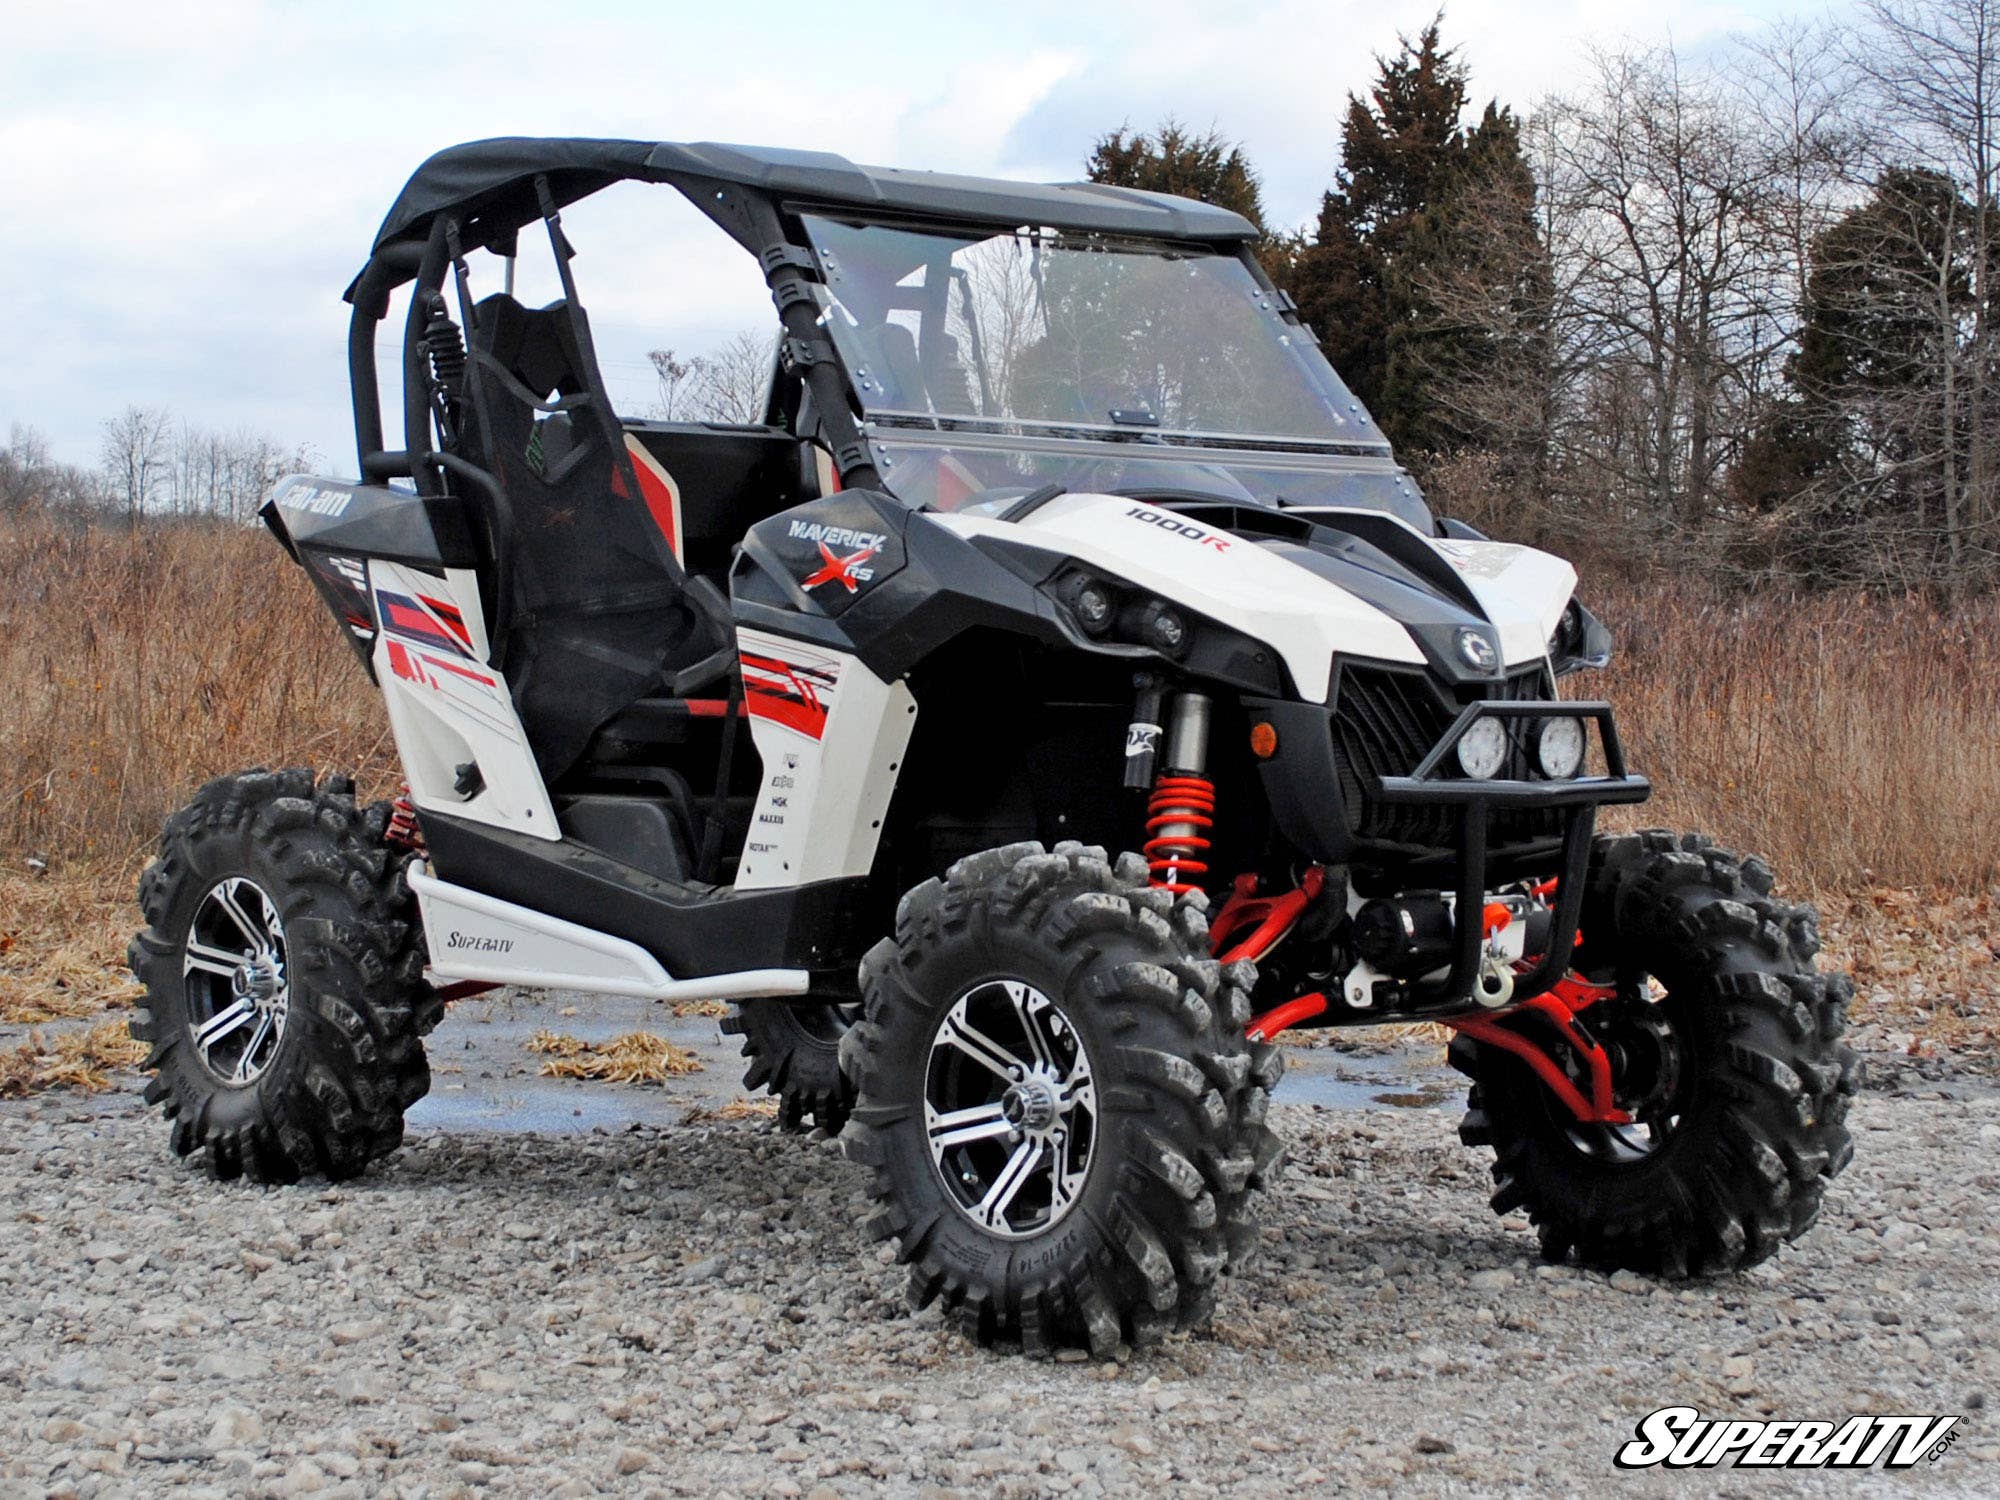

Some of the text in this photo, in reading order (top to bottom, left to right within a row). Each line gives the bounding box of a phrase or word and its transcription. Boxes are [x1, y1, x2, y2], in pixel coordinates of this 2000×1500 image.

[281, 484, 351, 516] can-am
[788, 520, 887, 552] MAVERICK
[1126, 508, 1231, 553] 1000R
